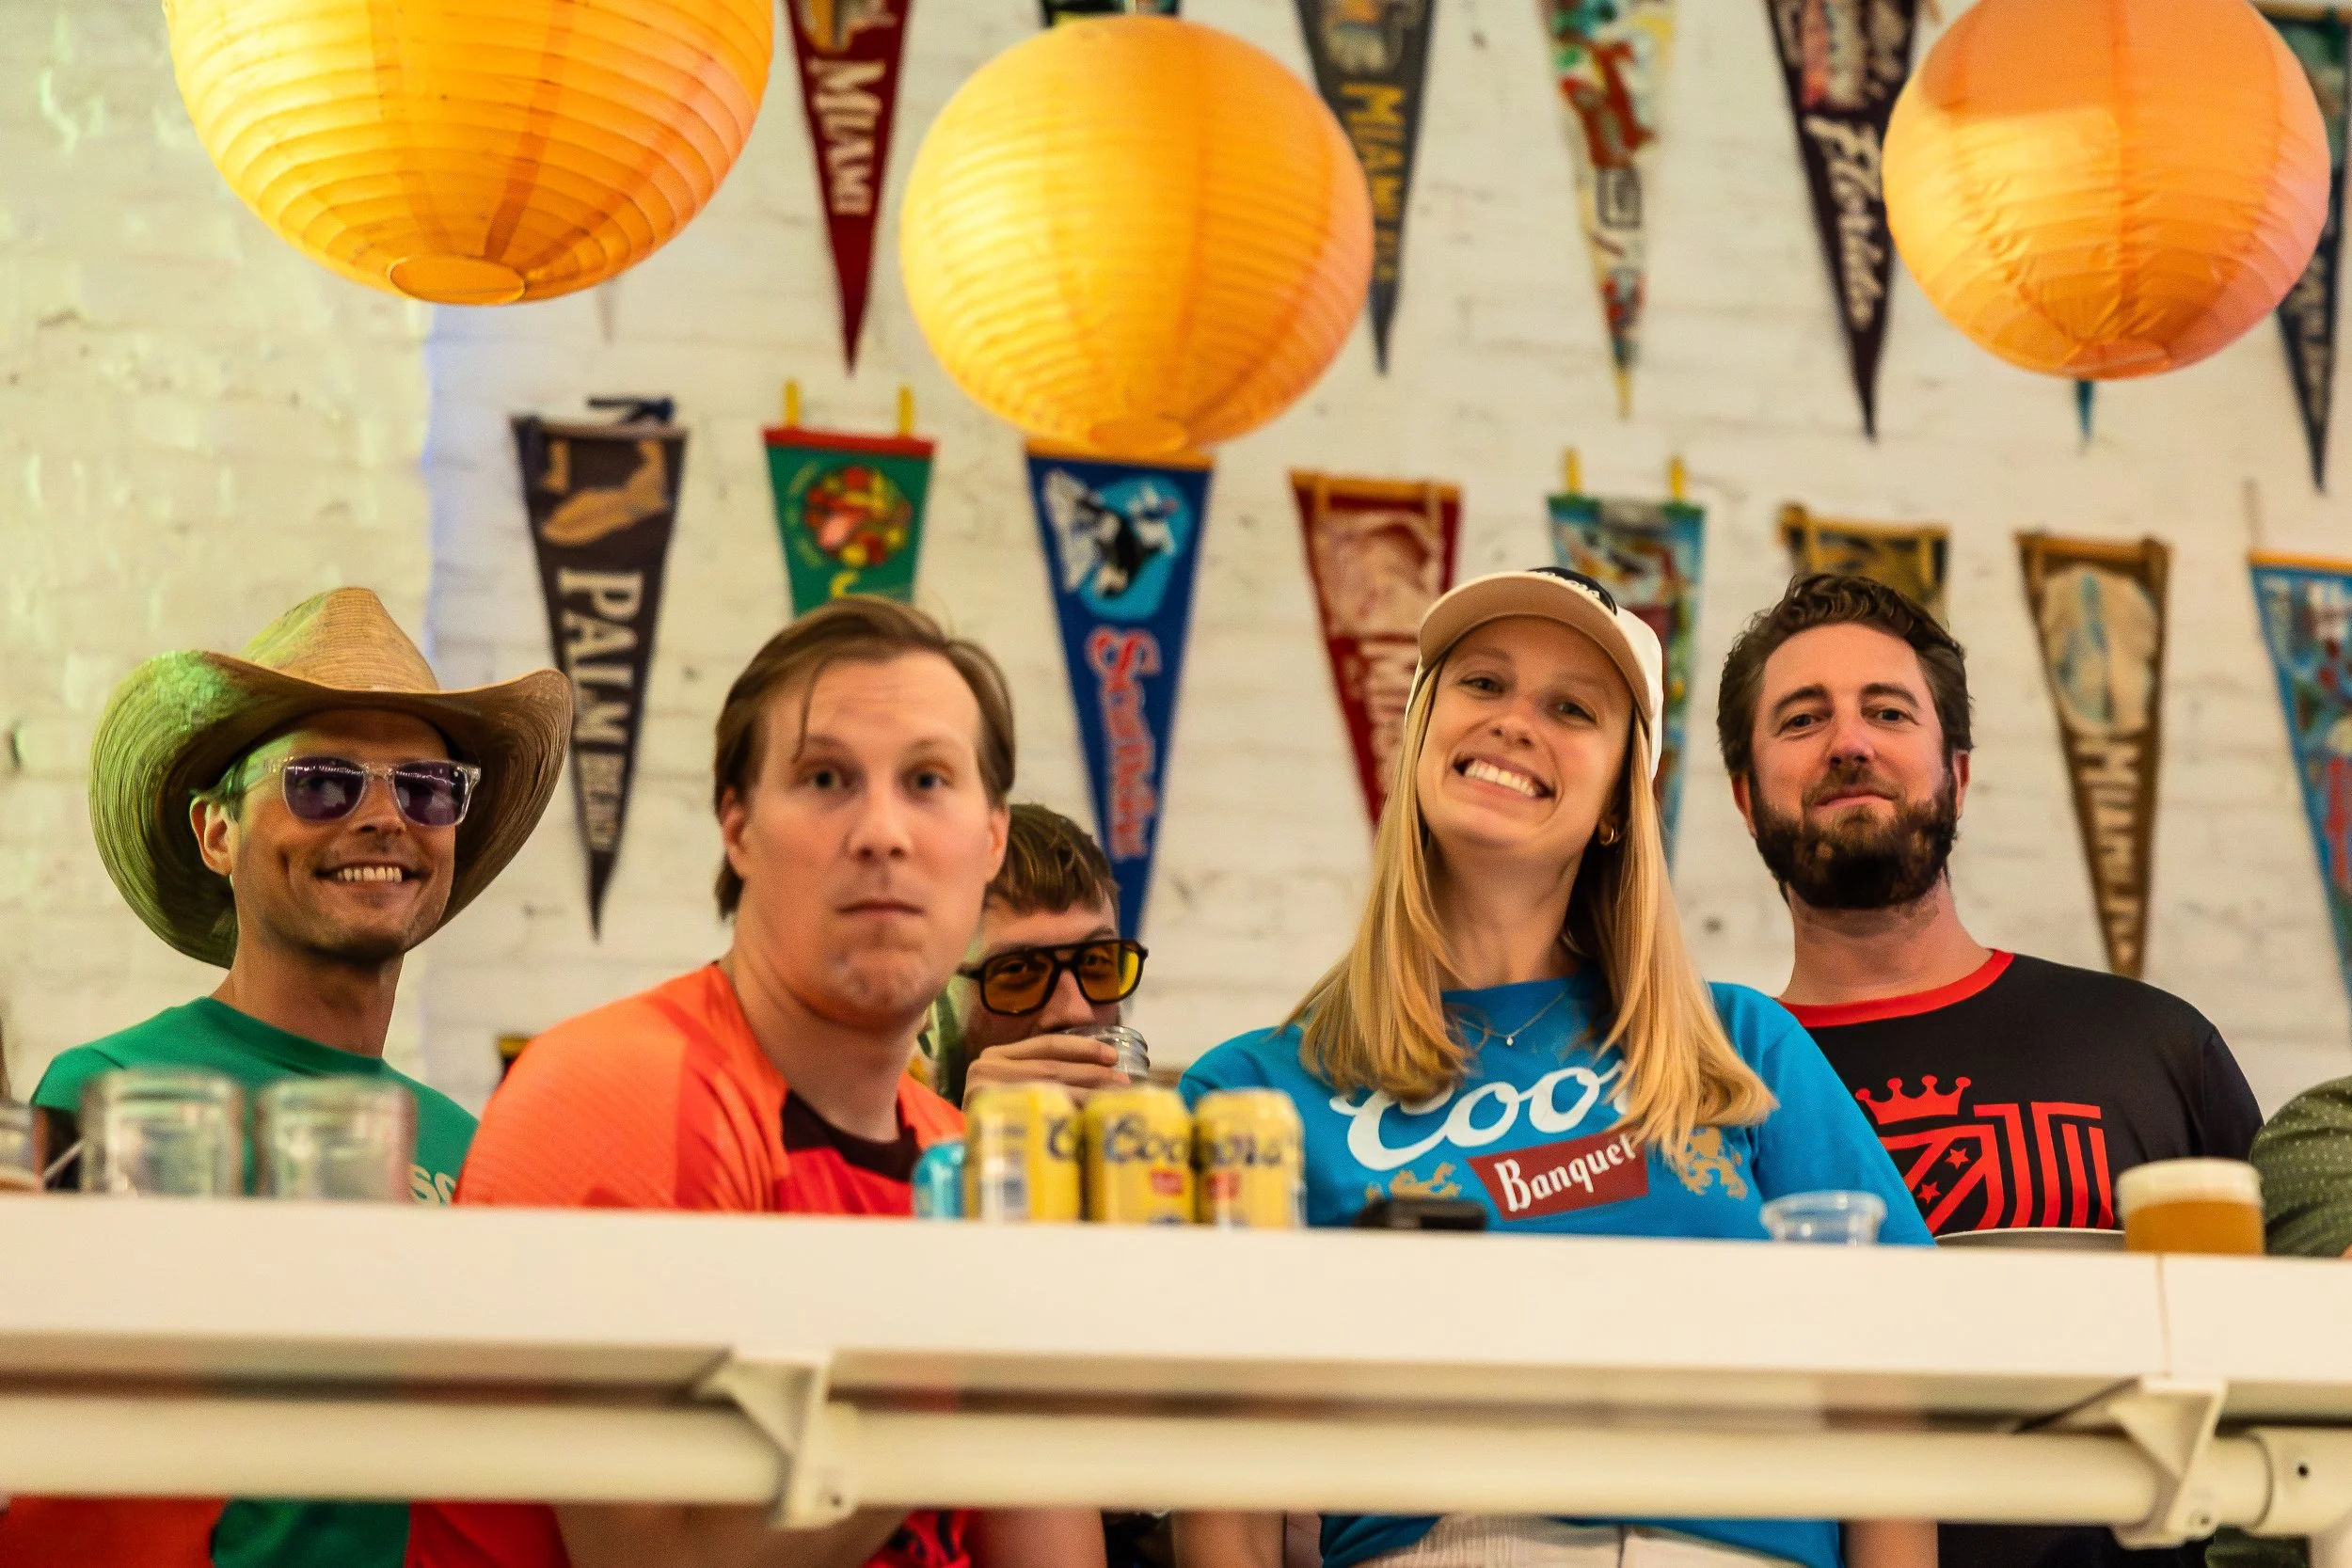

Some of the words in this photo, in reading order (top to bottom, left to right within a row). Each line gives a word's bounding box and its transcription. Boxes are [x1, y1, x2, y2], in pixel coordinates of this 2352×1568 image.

[806, 59, 886, 216] MIAMI
[557, 570, 644, 744] PALM
[1329, 1059, 1631, 1171] Coo
[1494, 1132, 1636, 1212] Banquet
